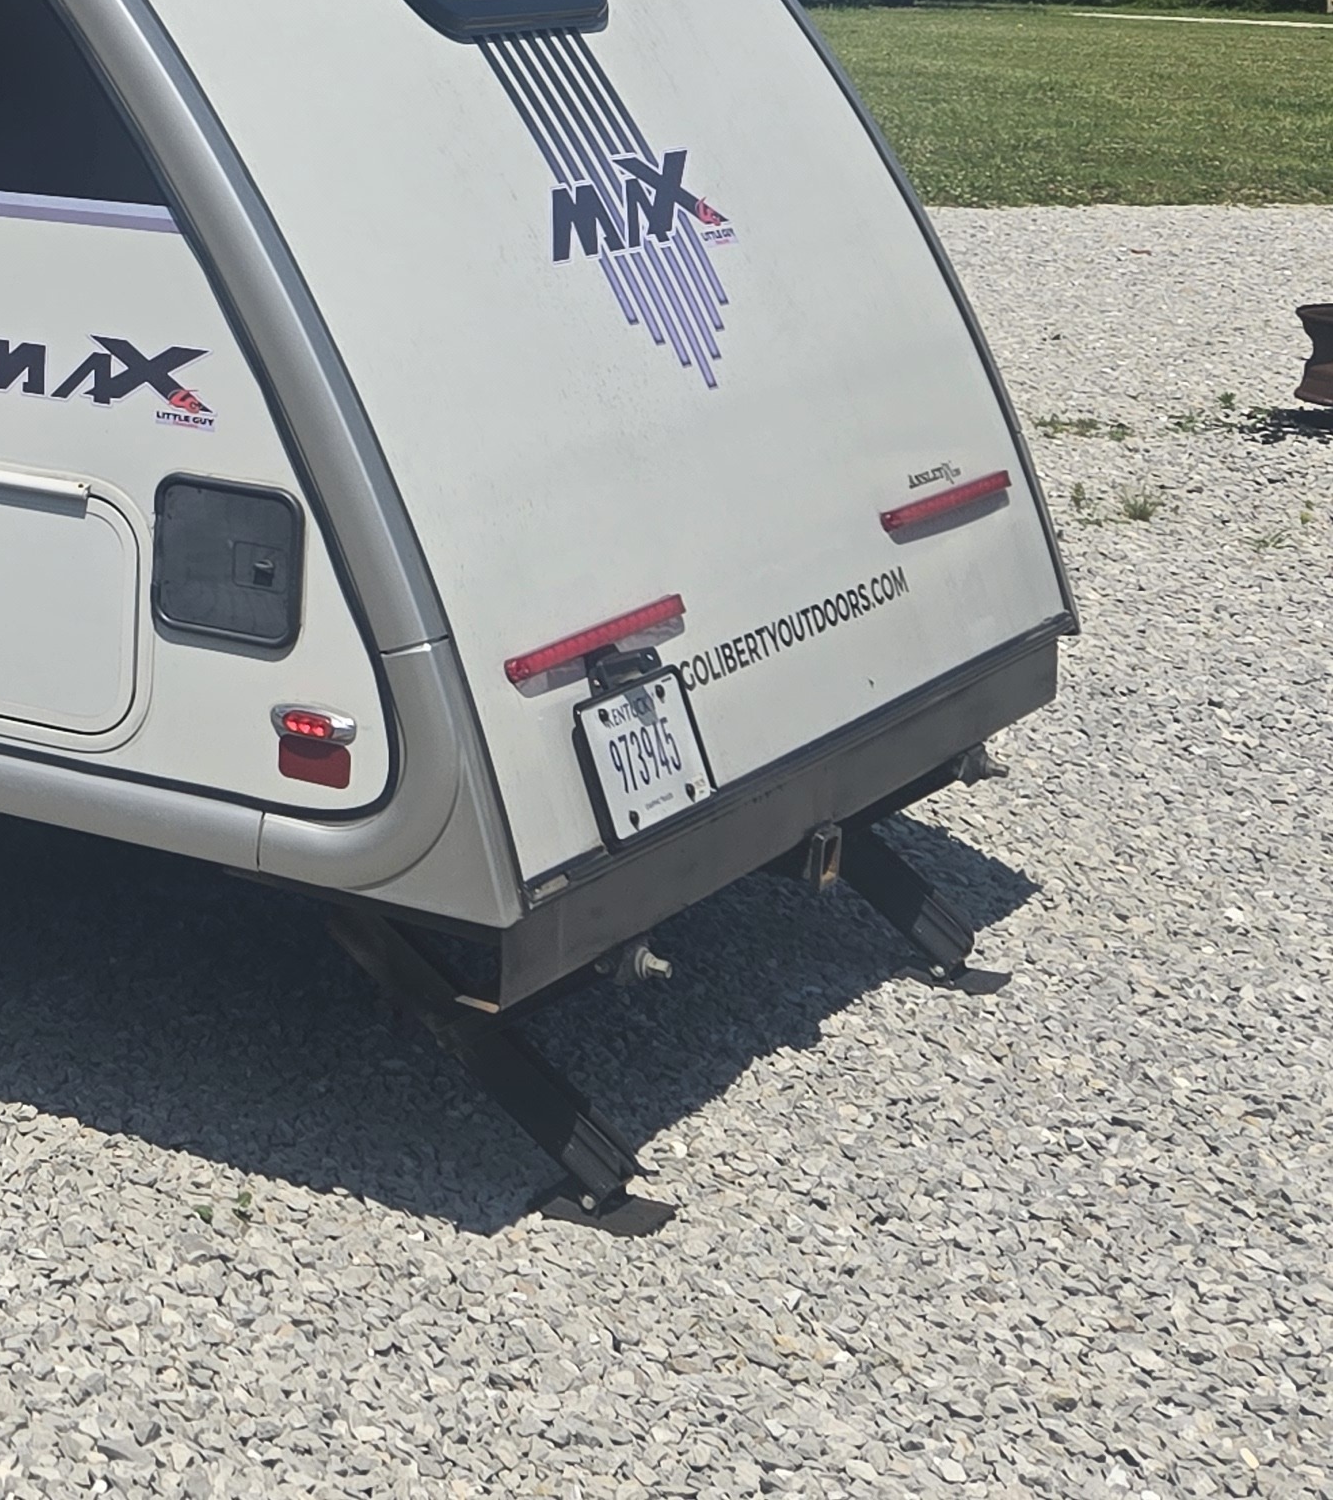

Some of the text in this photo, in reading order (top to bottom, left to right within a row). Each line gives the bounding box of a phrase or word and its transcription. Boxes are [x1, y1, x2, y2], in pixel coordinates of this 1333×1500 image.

[552, 150, 729, 262] MAX
[156, 410, 191, 423] LITTLE
[192, 416, 214, 427] GUY
[609, 717, 682, 794] 973945
